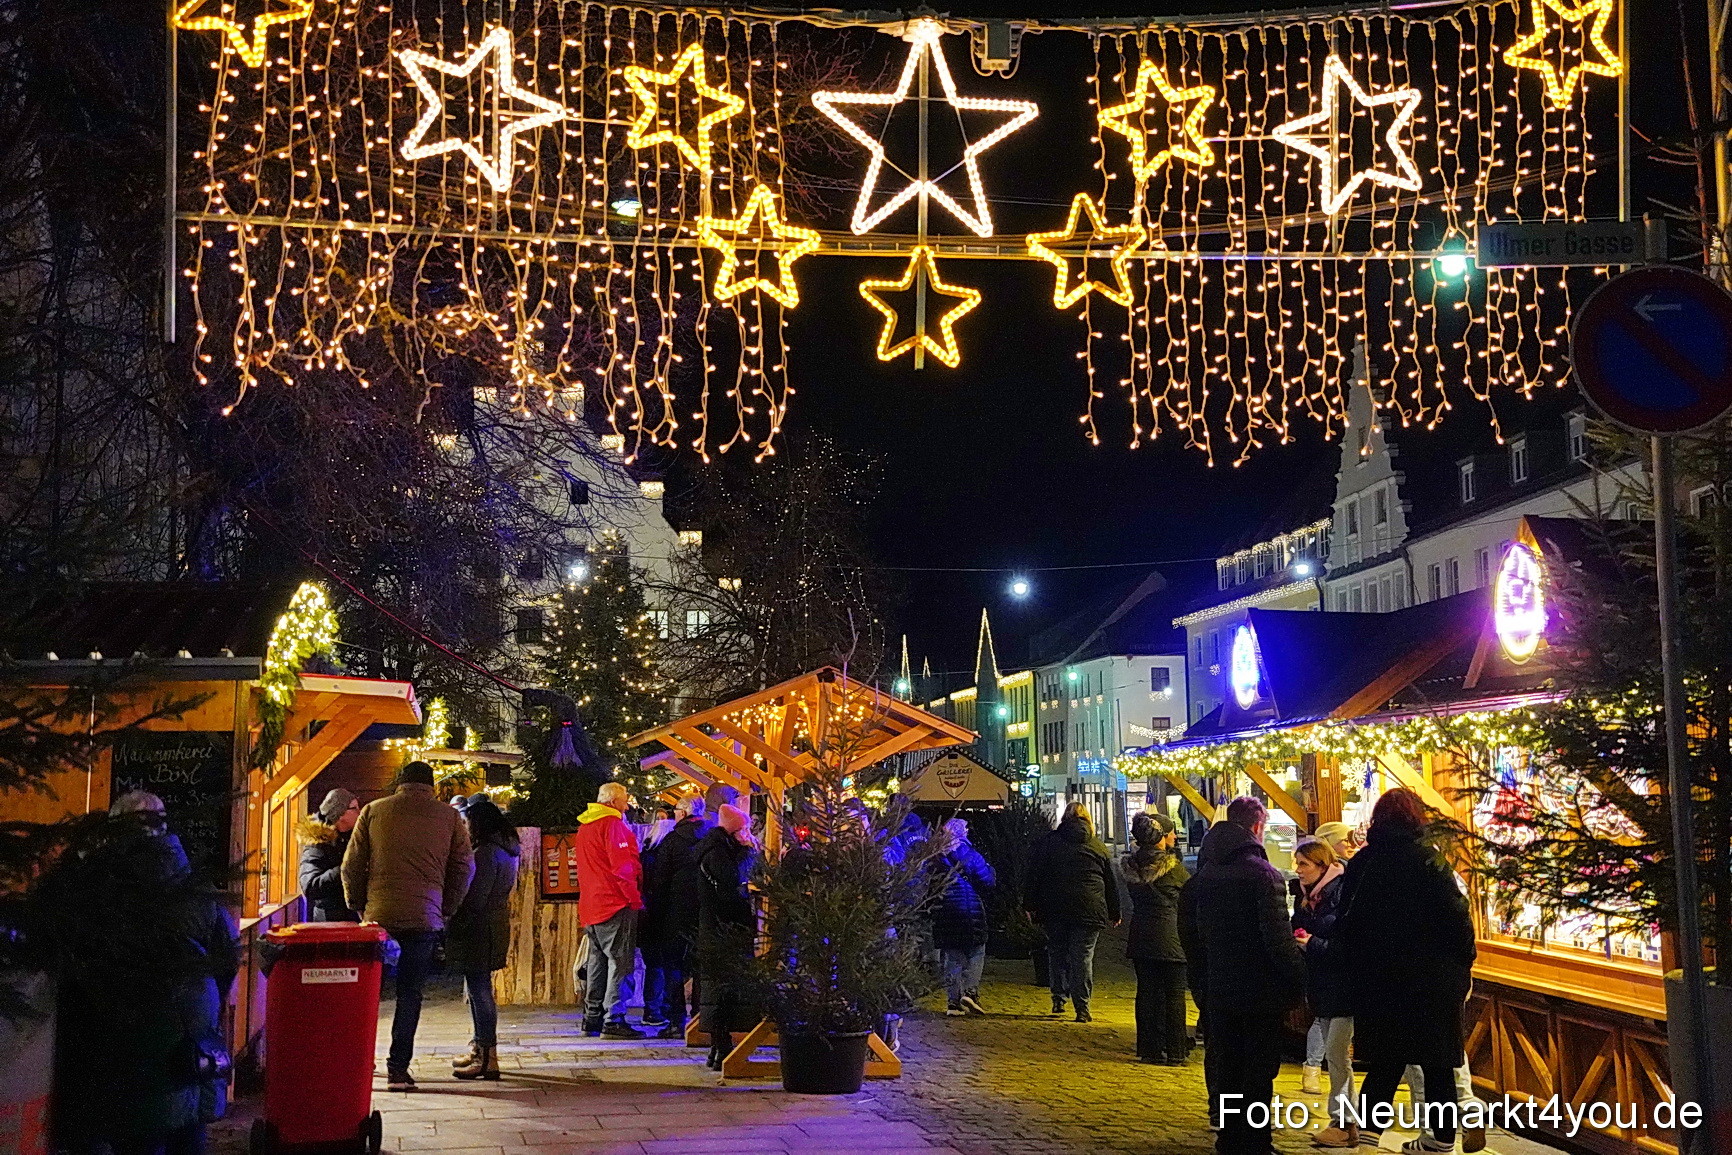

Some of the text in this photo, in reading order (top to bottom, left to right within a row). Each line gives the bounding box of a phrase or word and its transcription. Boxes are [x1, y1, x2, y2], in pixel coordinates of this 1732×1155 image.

[1489, 230, 1634, 256] Ulmer Gasse
[304, 969, 348, 978] NEUMARKT
